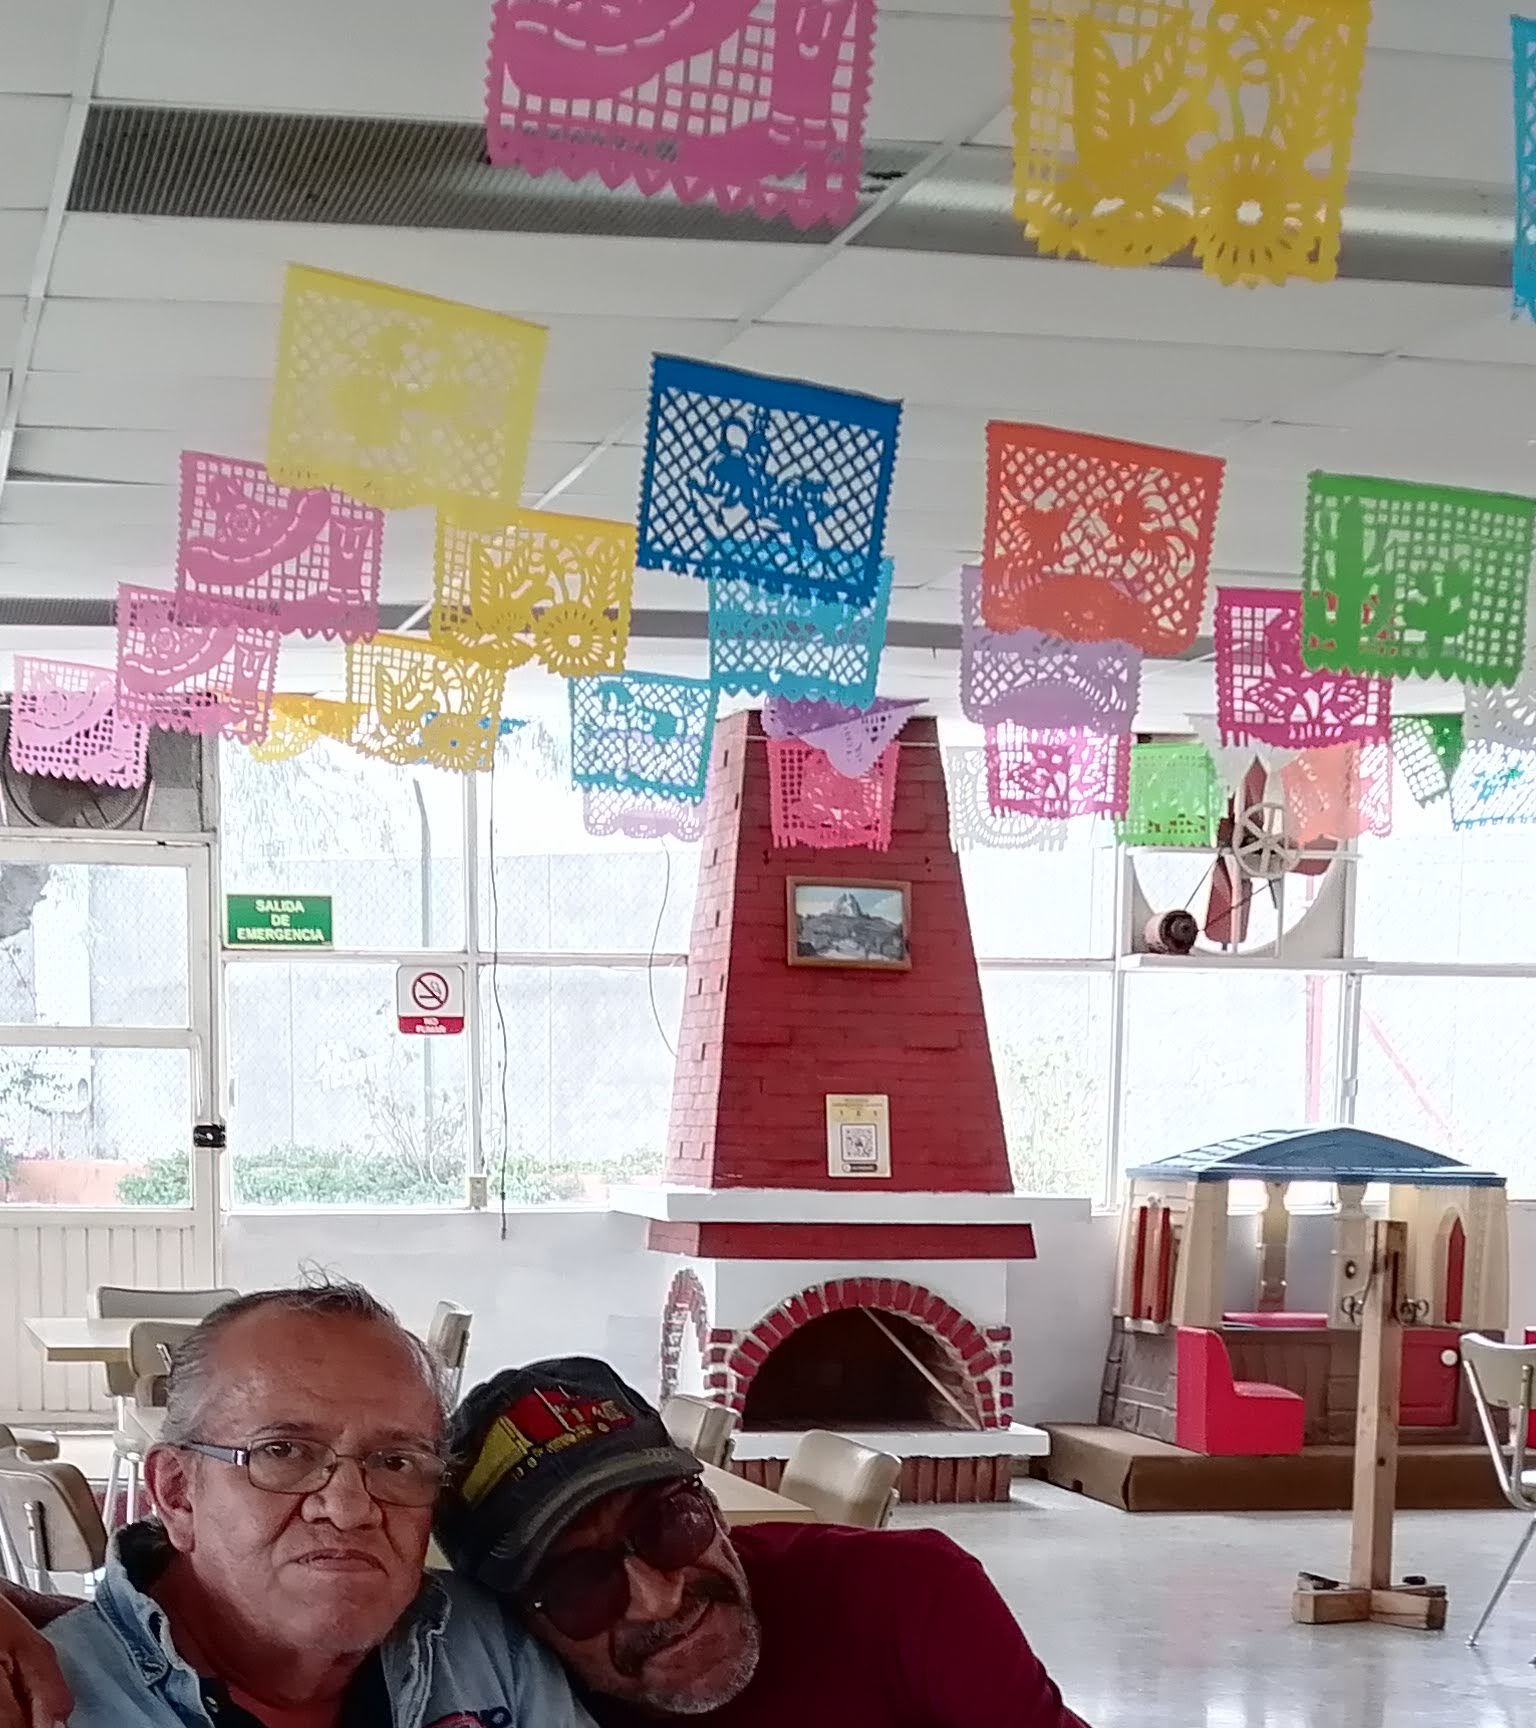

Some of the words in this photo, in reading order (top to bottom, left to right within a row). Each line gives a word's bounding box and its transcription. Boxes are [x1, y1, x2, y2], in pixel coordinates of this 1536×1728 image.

[255, 899, 305, 913] SALIDA
[270, 913, 290, 927] DE
[236, 927, 325, 941] EMERGENCIA
